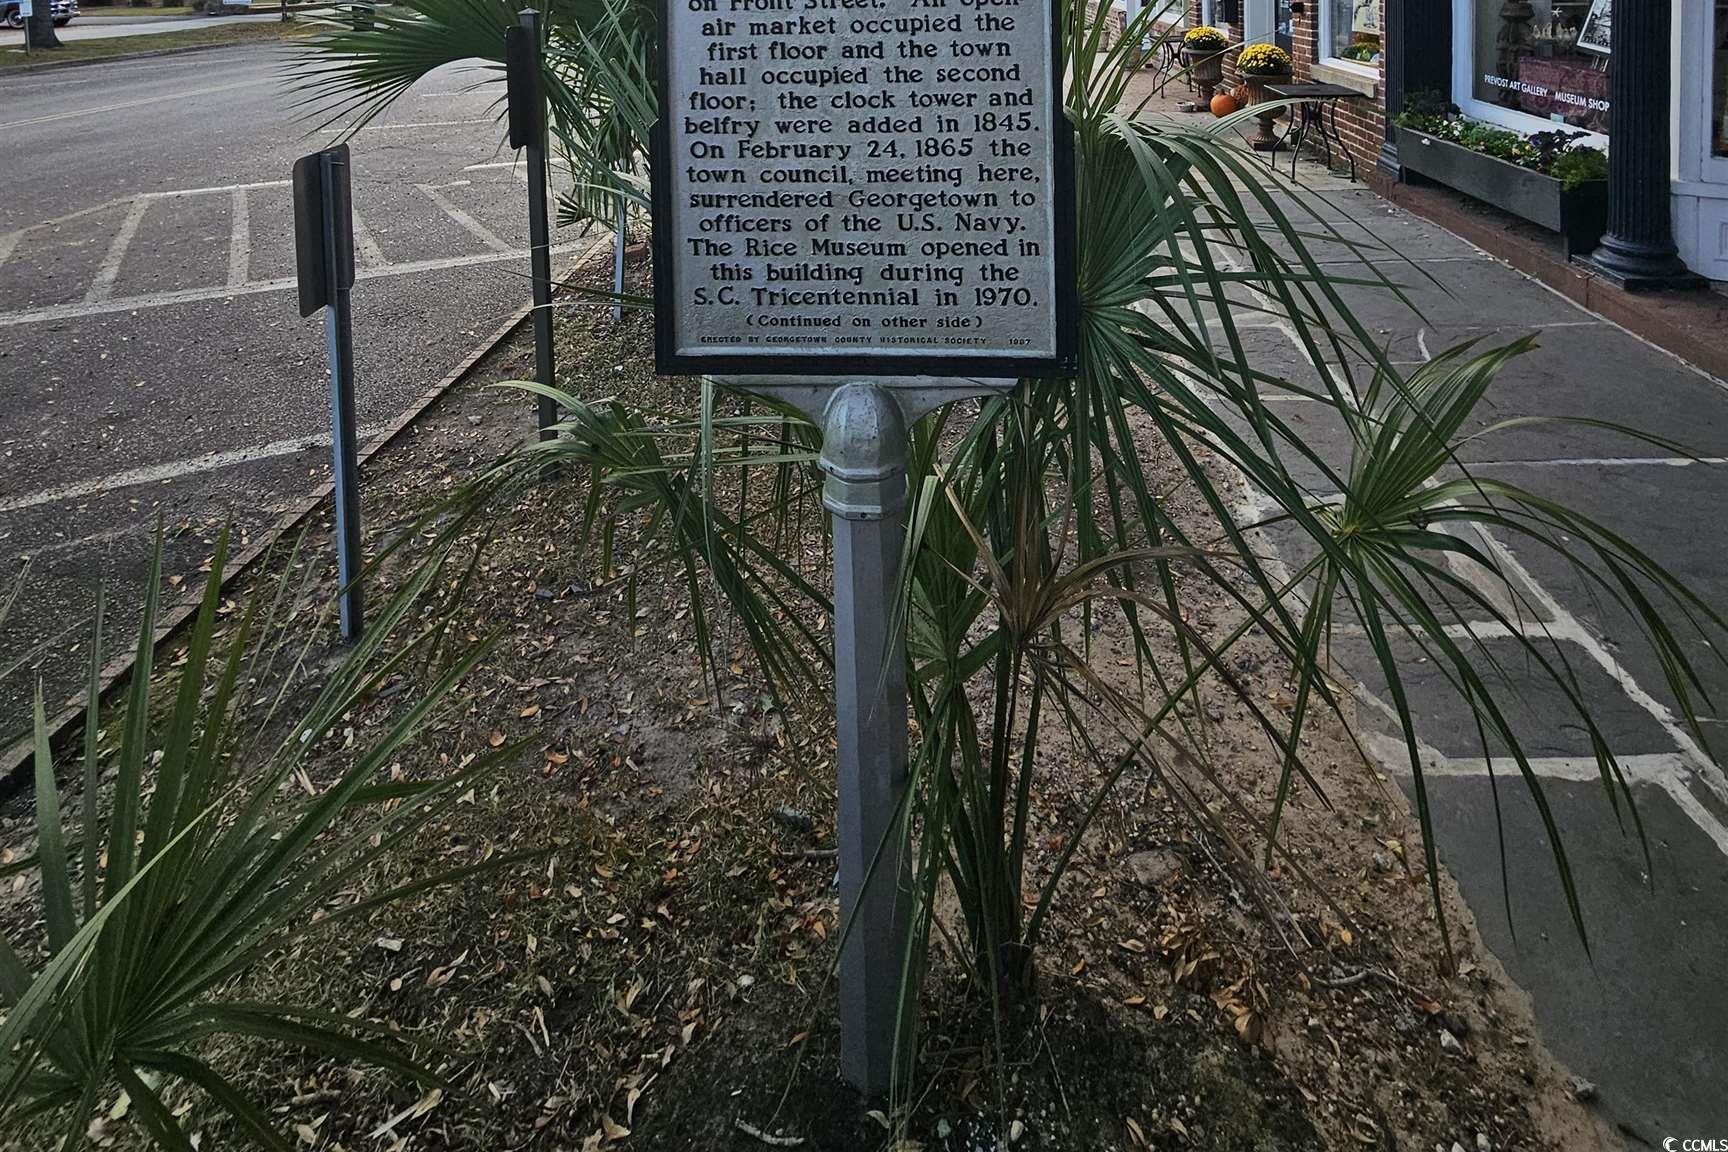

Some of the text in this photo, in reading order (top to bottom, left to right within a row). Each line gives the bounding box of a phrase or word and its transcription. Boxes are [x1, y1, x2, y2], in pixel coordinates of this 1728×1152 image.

[702, 14, 1015, 37] air market occupied the
[707, 41, 1011, 61] first floor and the town
[699, 64, 1020, 87] hall occupied the second
[1484, 75, 1548, 97] PREVOST ART GALLERY
[689, 89, 1033, 112] floor; the clock tower and
[1555, 92, 1610, 111] MUSEUM SHOP
[685, 113, 1040, 138] belfry were added in 1845.
[690, 141, 724, 159] On
[738, 141, 851, 161] February
[916, 138, 973, 157] 1865
[989, 139, 1032, 157] the
[687, 164, 1040, 185] town council, meeting here,
[689, 190, 1036, 210] surrendered Georgetown to
[699, 214, 1026, 234] officers of the U.S. Navy.
[688, 238, 1040, 258] The Rice Museum opened in
[710, 263, 1019, 284] this building during the
[694, 287, 1038, 307] S.C. Tricentennial in 1970.
[852, 316, 871, 327] on
[881, 315, 927, 327] other
[701, 335, 742, 343] ERECTED
[748, 335, 760, 343] BY
[765, 335, 827, 343] GEORGETOWN
[835, 335, 872, 343] COUNTY
[880, 336, 938, 344] HISTORICAL
[945, 336, 986, 344] SOCIETY
